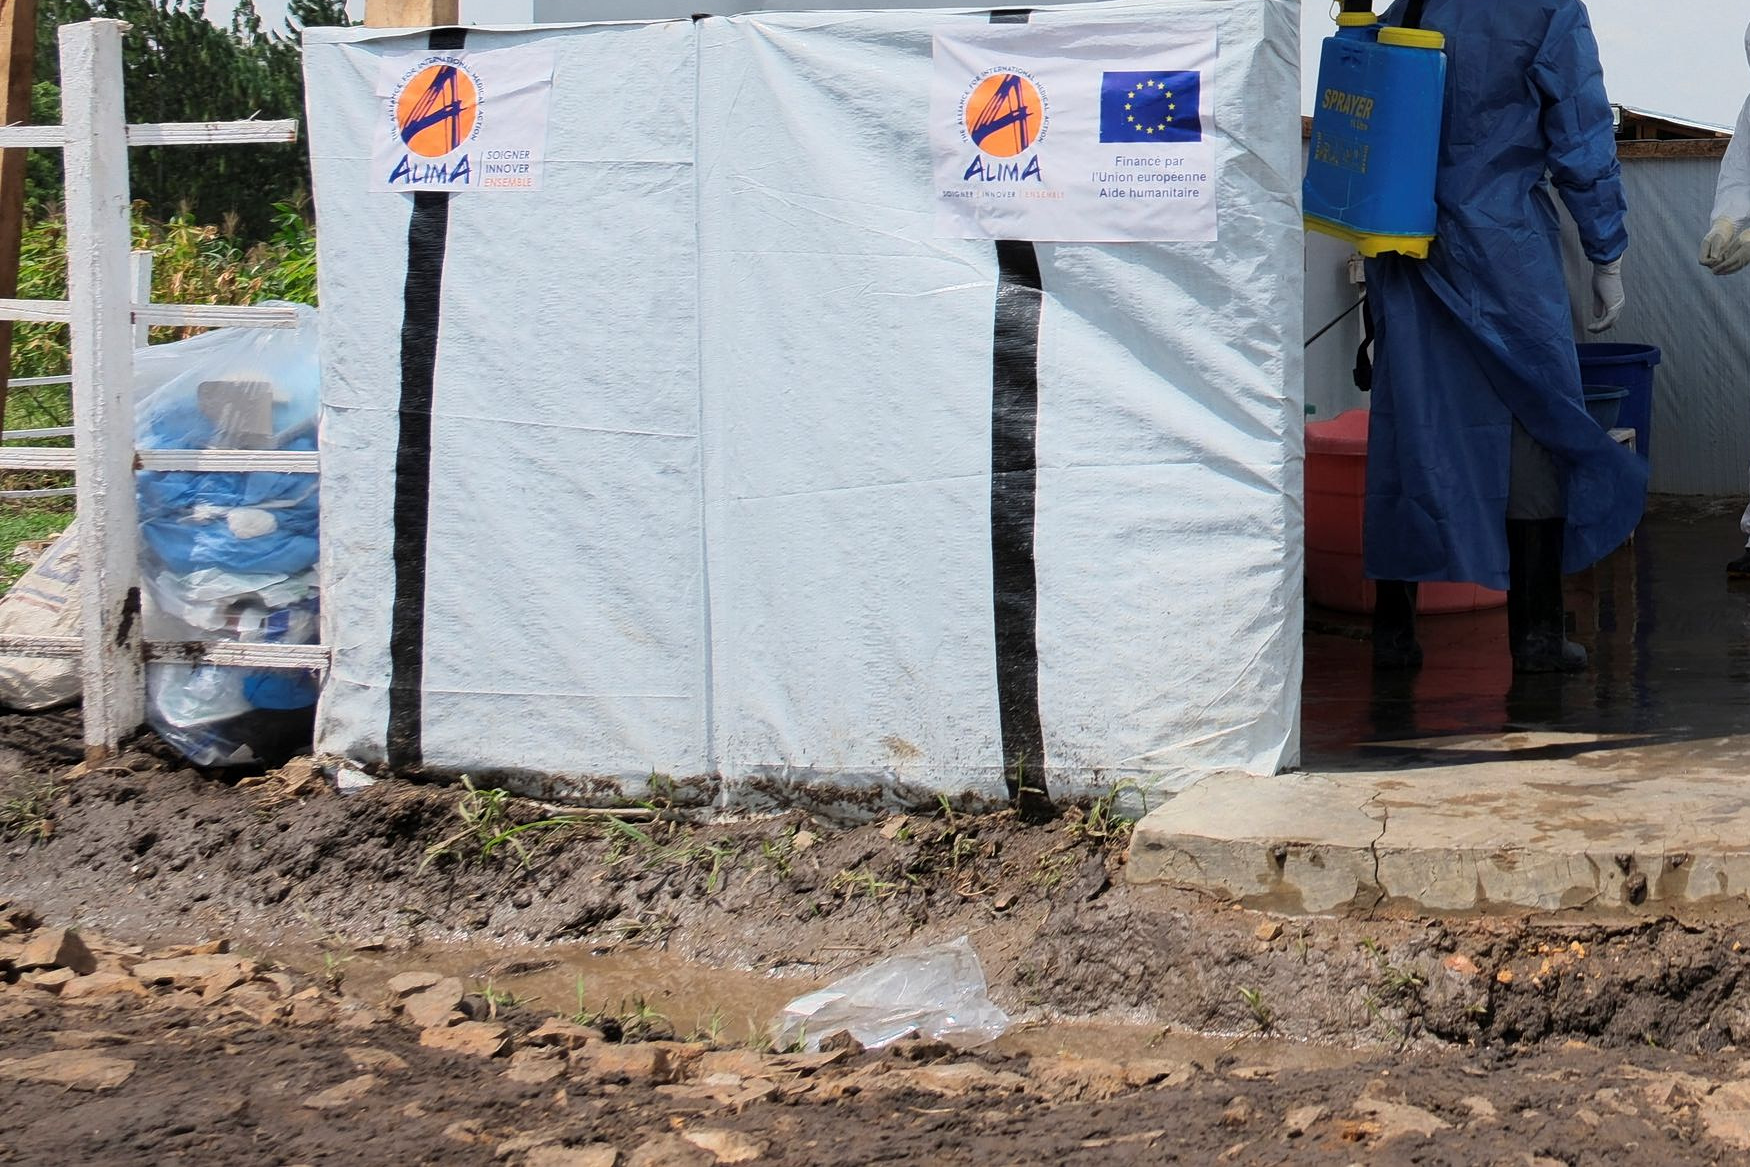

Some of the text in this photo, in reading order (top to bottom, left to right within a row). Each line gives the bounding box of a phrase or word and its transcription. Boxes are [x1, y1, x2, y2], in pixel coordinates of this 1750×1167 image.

[1322, 88, 1374, 119] SPRAYER
[470, 110, 484, 141] ACTION
[487, 150, 530, 160] SOIGNER
[963, 154, 1042, 182] ALIMA
[1115, 156, 1184, 168] Financé par
[388, 154, 472, 184] ALIMA
[485, 164, 530, 173] INNOVER
[484, 178, 532, 187] ENSEMBLE
[1092, 171, 1207, 183] l'Union européenne
[1099, 188, 1200, 198] Aide humanitaire
